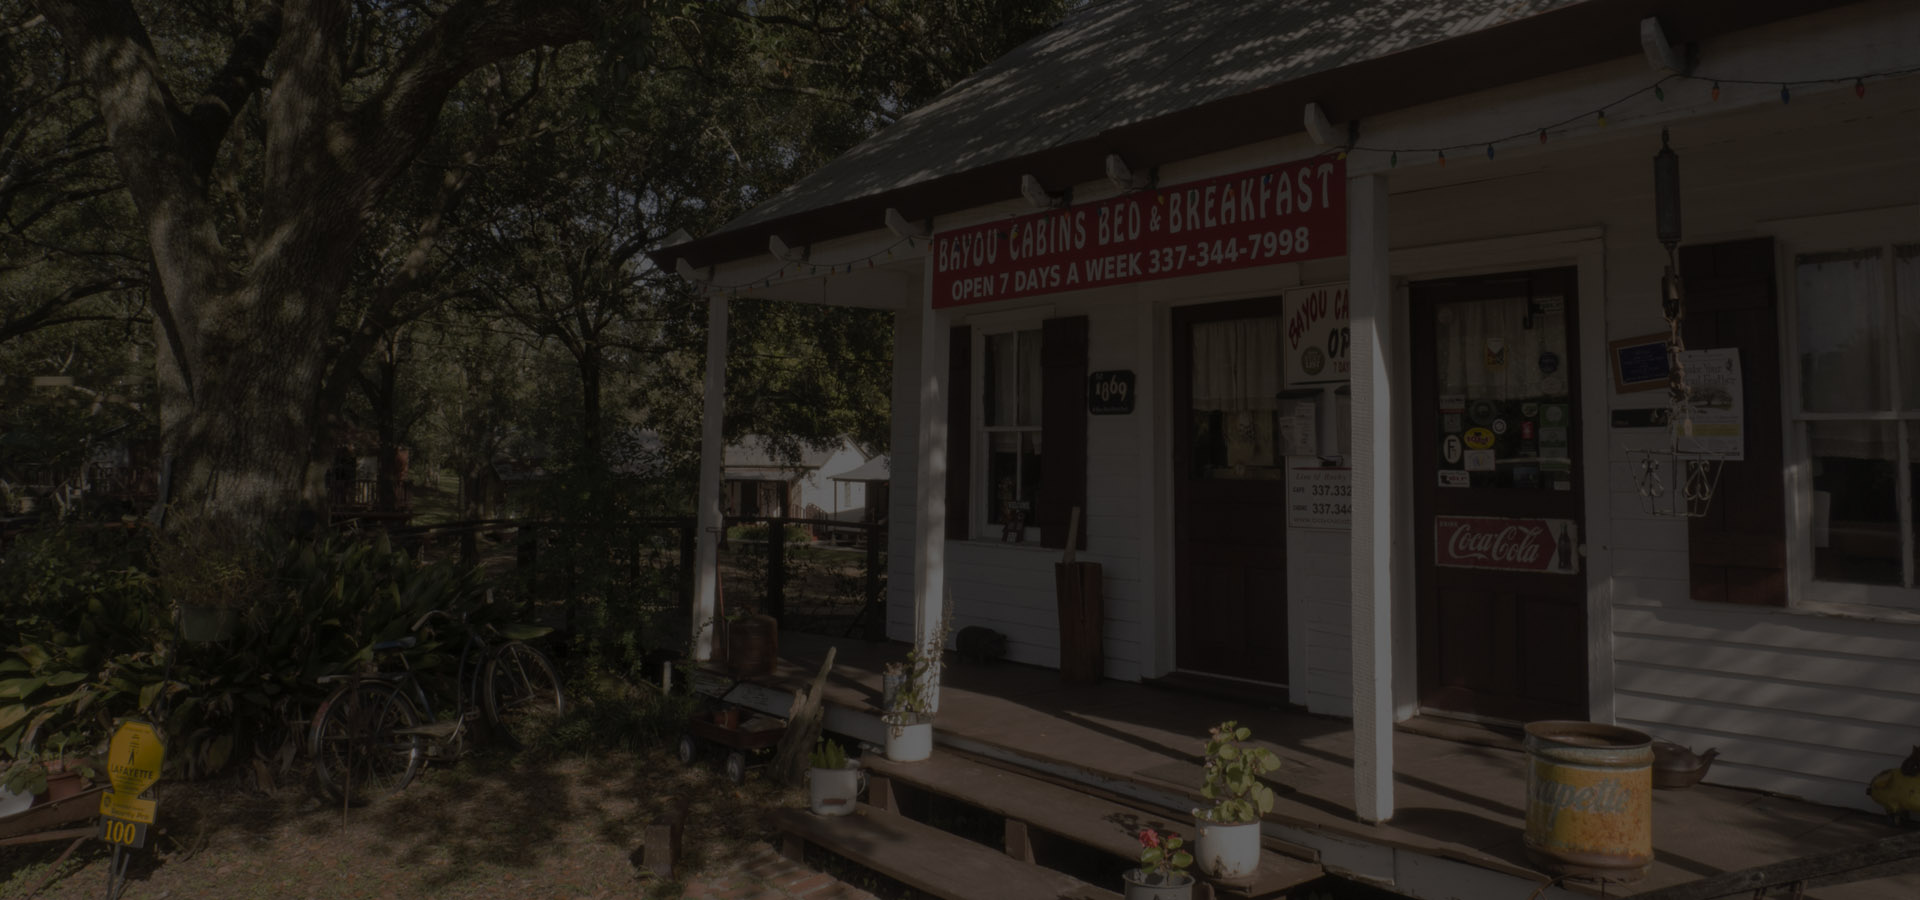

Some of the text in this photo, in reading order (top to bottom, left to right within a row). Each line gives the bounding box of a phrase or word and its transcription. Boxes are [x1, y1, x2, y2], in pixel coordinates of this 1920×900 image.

[938, 162, 1335, 273] BAYOU CABINS BED & BREAKFAST
[952, 226, 1310, 301] OPEN 7 DAYS A WEEK 337-344-7998
[1288, 288, 1350, 350] BAYOU CA
[1327, 326, 1350, 359] OP
[1095, 374, 1128, 402] 1869
[111, 764, 154, 780] LAFAYETTE
[104, 818, 136, 846] 100
